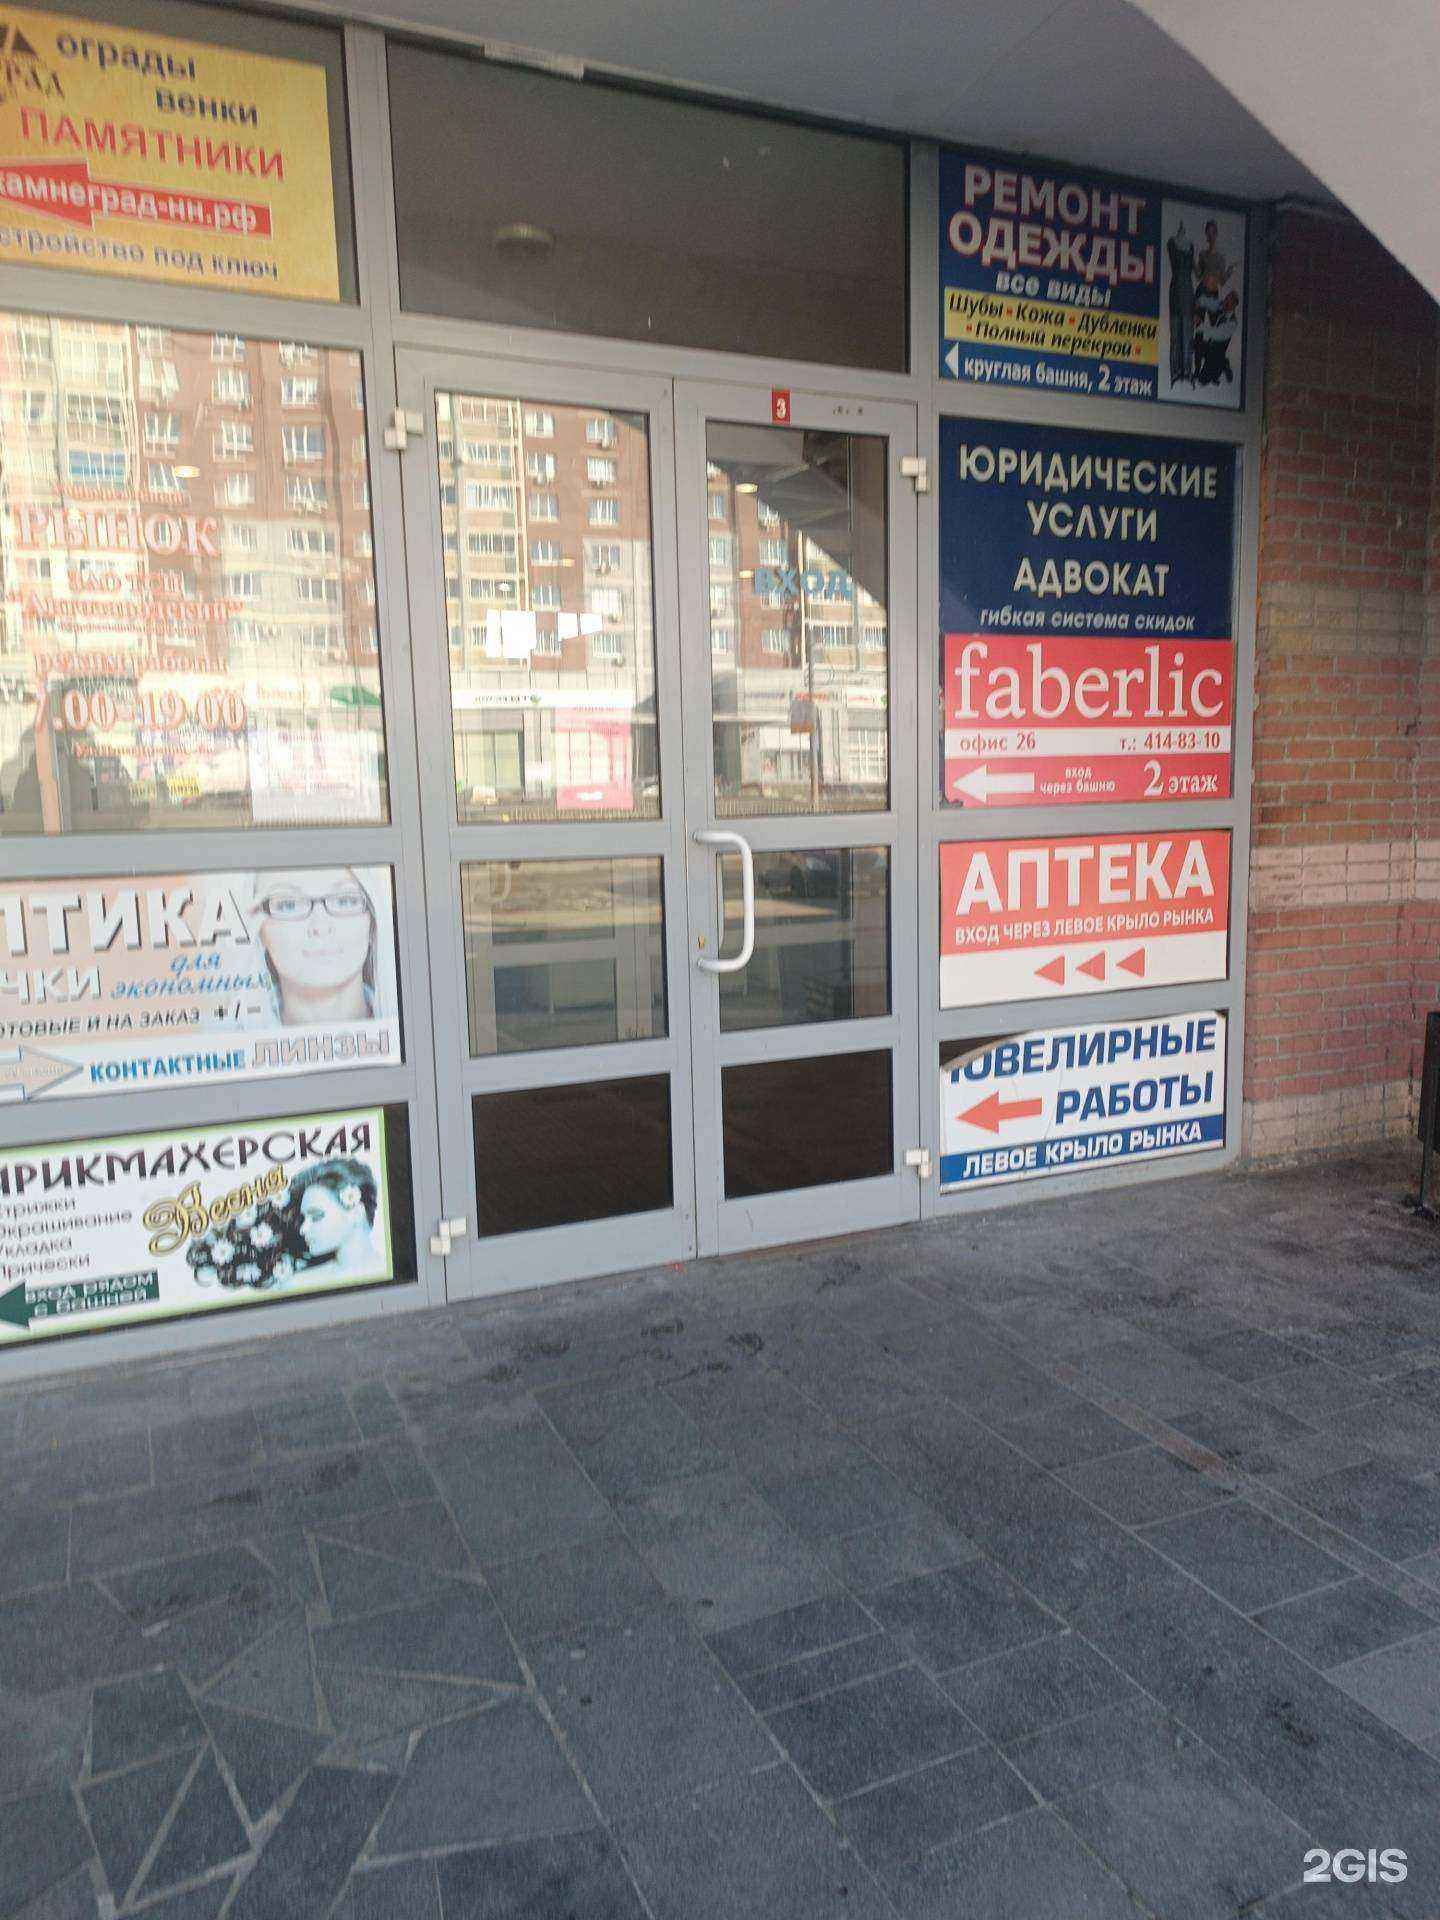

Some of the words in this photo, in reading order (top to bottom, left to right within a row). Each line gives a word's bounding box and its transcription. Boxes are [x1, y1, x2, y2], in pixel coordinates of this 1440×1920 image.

[56, 32, 196, 81] ограды
[155, 87, 258, 127] венки
[20, 105, 285, 182] ПАМЯТНИКИ
[964, 164, 1146, 234] РЕМОНТ
[153, 246, 204, 276] под
[211, 253, 279, 281] ключ
[949, 210, 1154, 286] ОДЕЖДЫ
[996, 270, 1040, 298] все
[1047, 280, 1112, 308] виды
[948, 292, 1004, 320] Шубы
[1015, 303, 1065, 328] Кожа
[1077, 310, 1159, 340] Дубленки
[975, 320, 1045, 346] Полный
[1050, 331, 1133, 359] перекрой
[964, 358, 1031, 384] круглая
[1036, 362, 1092, 393] башня,
[1098, 367, 1111, 392] 2
[1114, 377, 1153, 398] этаж
[775, 397, 788, 419] 3
[959, 443, 1218, 500] ЮРИДИЧЕСКИЕ
[1026, 500, 1158, 542] УСЛУГИ
[1013, 556, 1170, 599] АДВОКАТ
[979, 605, 1045, 628] гибкая
[1051, 610, 1128, 631] система
[1134, 614, 1195, 633] скидок
[954, 640, 1224, 720] faberlic
[959, 732, 1008, 757] офис
[1015, 731, 1036, 751] 26
[1143, 730, 1221, 751] 414-83-10
[1065, 764, 1092, 780] вход
[1143, 759, 1164, 797] 2
[1167, 773, 1219, 794] этаж
[956, 839, 1216, 916] АПТЕКА
[954, 924, 1001, 946] ВХОД
[1003, 920, 1052, 941] ЧЕРЕЗ
[1053, 916, 1104, 938] ЛЕВОЕ
[1106, 911, 1160, 933] КРЫЛО
[1163, 906, 1215, 927] РЫНКА
[169, 951, 224, 977] для
[110, 970, 270, 1000] экономных
[86, 1012, 101, 1032] И
[106, 1010, 133, 1031] НА
[139, 1006, 200, 1028] ЗАКАЗ
[89, 1048, 246, 1083] КОНТАКТНЫЕ
[252, 1029, 391, 1068] ЛИНЗЫ
[950, 1018, 1217, 1084] ЮВЕЛИРНЫЕ
[1055, 1070, 1214, 1125] РАБОТЫ
[962, 1146, 1037, 1178] ЛЕВОЕ
[1044, 1134, 1123, 1165] КРЫЛО
[1129, 1120, 1202, 1152] РЫНКА
[0, 1197, 76, 1220] трижки
[142, 1164, 289, 1257] Весна
